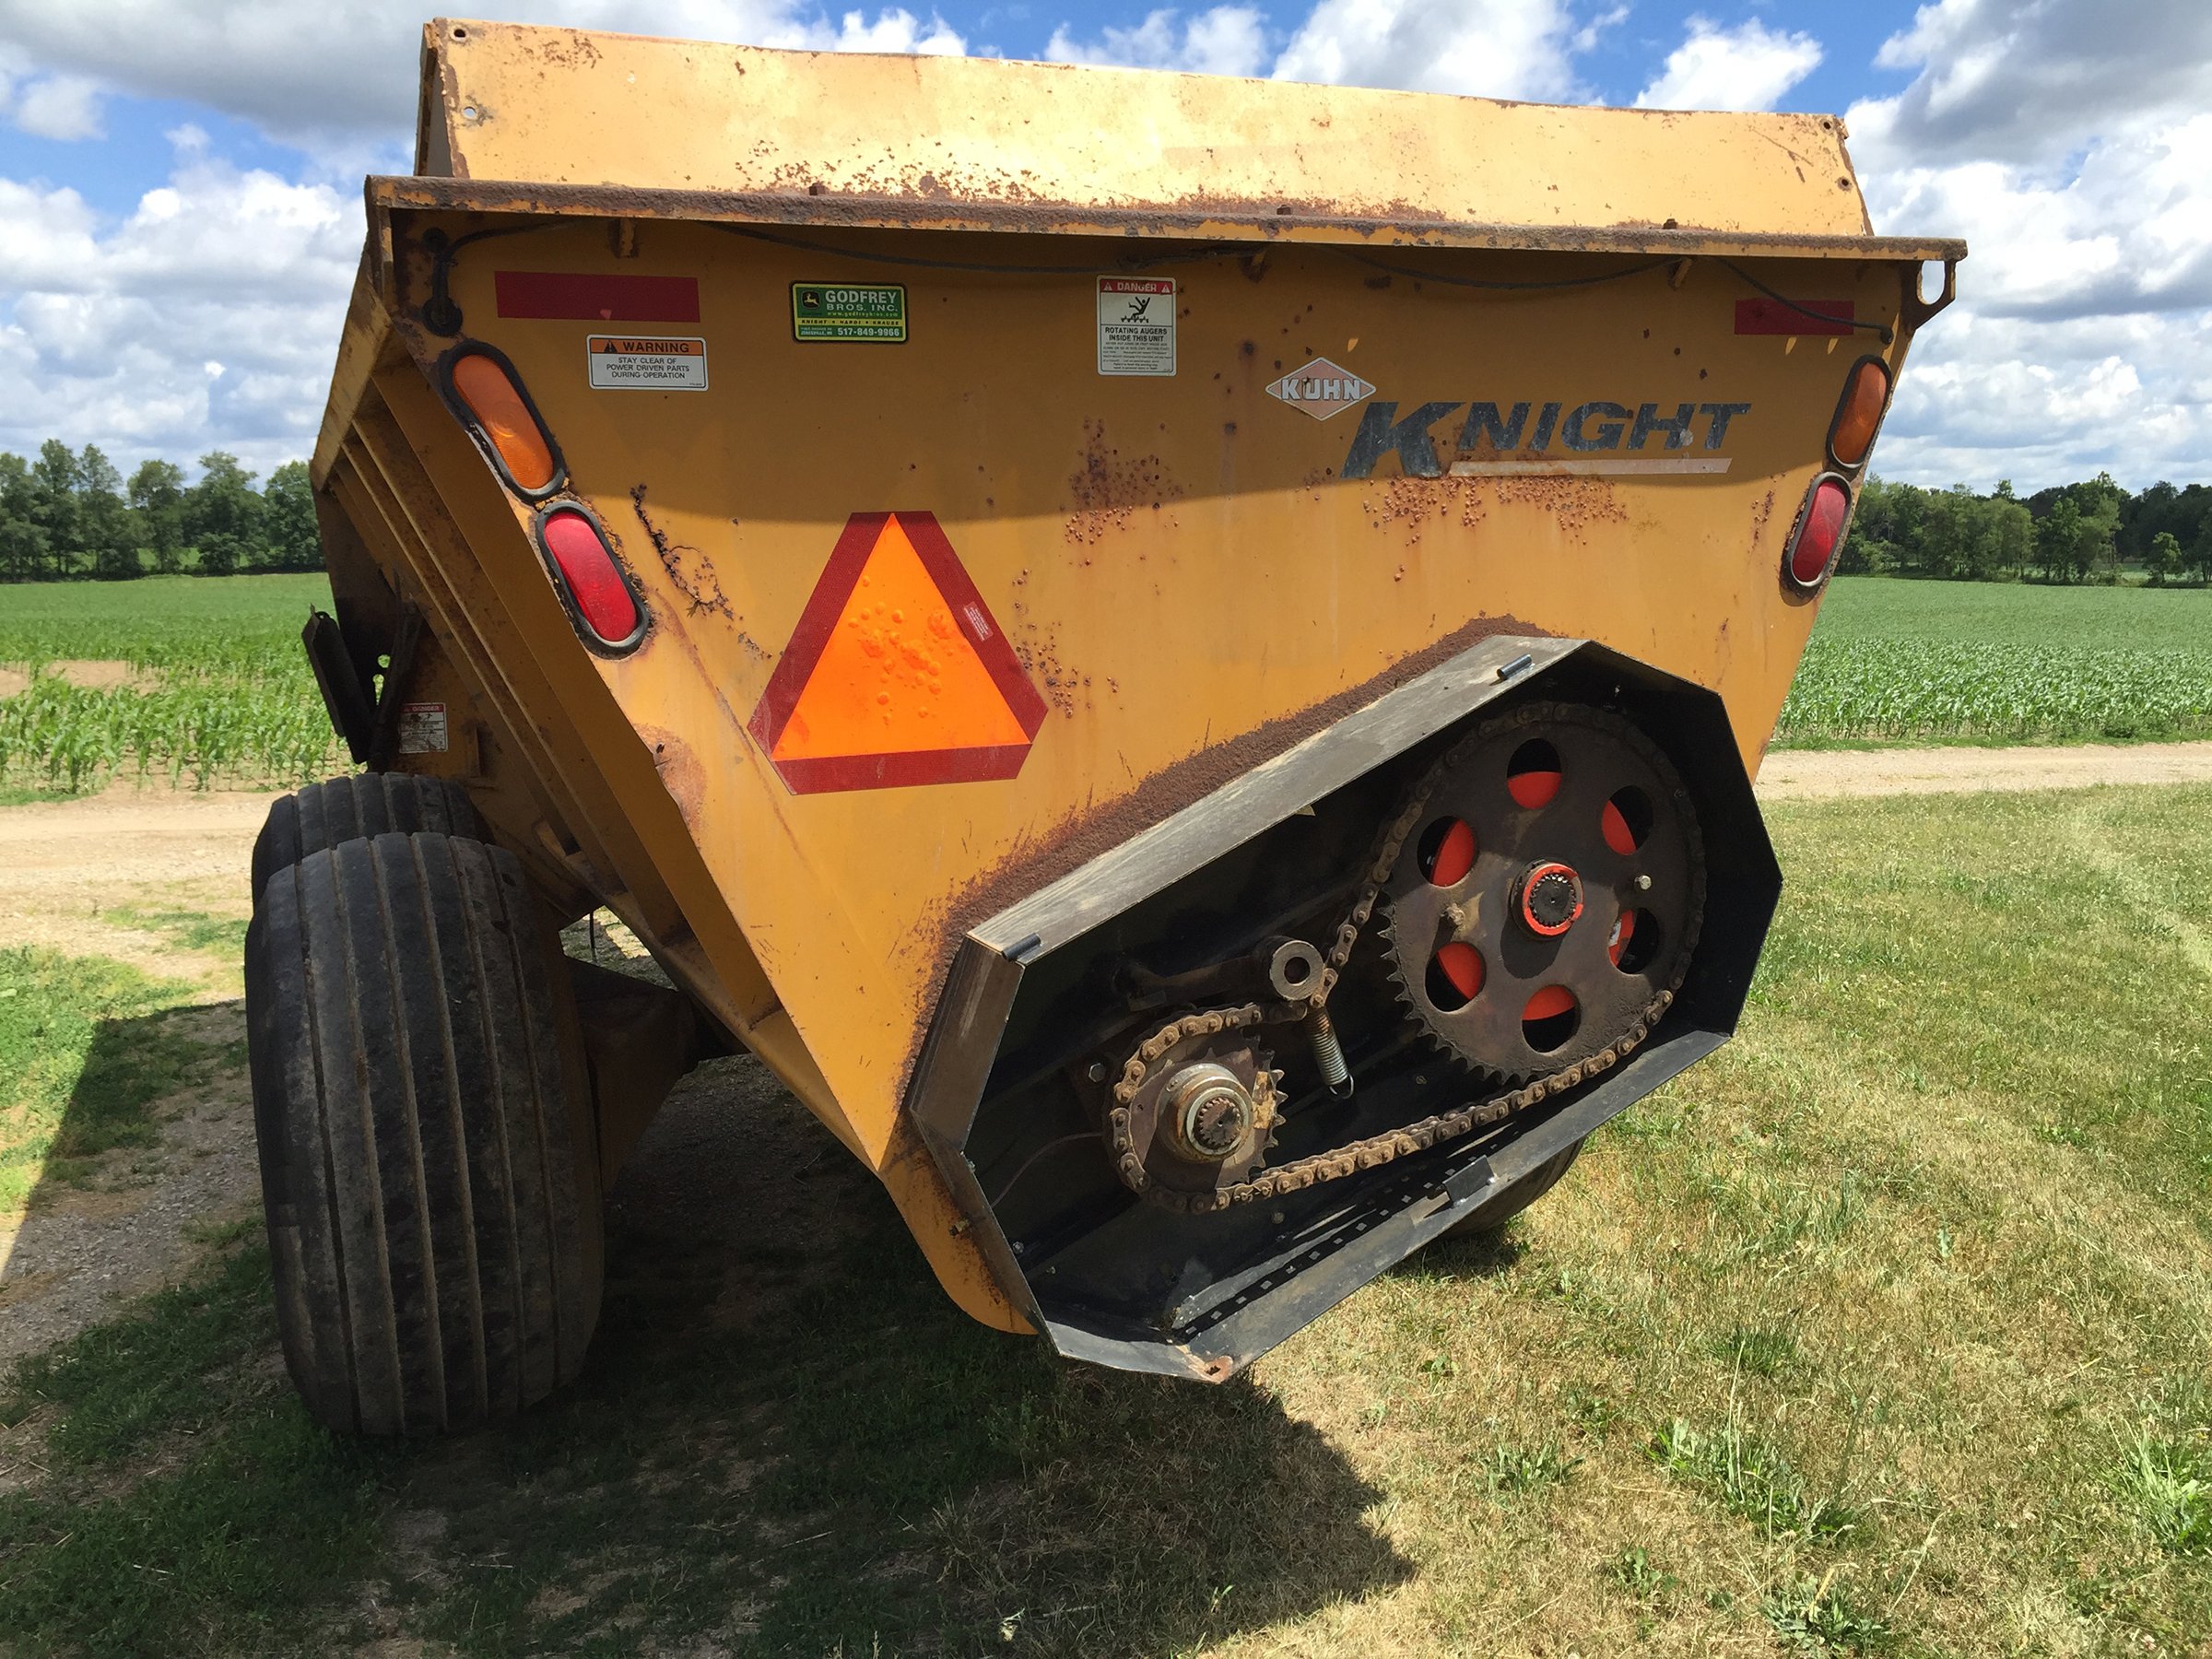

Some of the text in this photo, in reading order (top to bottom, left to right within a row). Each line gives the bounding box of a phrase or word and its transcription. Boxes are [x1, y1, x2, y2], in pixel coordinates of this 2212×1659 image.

[1117, 282, 1158, 292] DANGER
[825, 290, 897, 303] GODFREY
[826, 303, 866, 312] BROS.
[837, 327, 900, 336] 517-849-9966
[622, 342, 689, 353] WARNING
[1280, 378, 1361, 401] KUHN
[1340, 402, 1752, 478] KNIGHT
